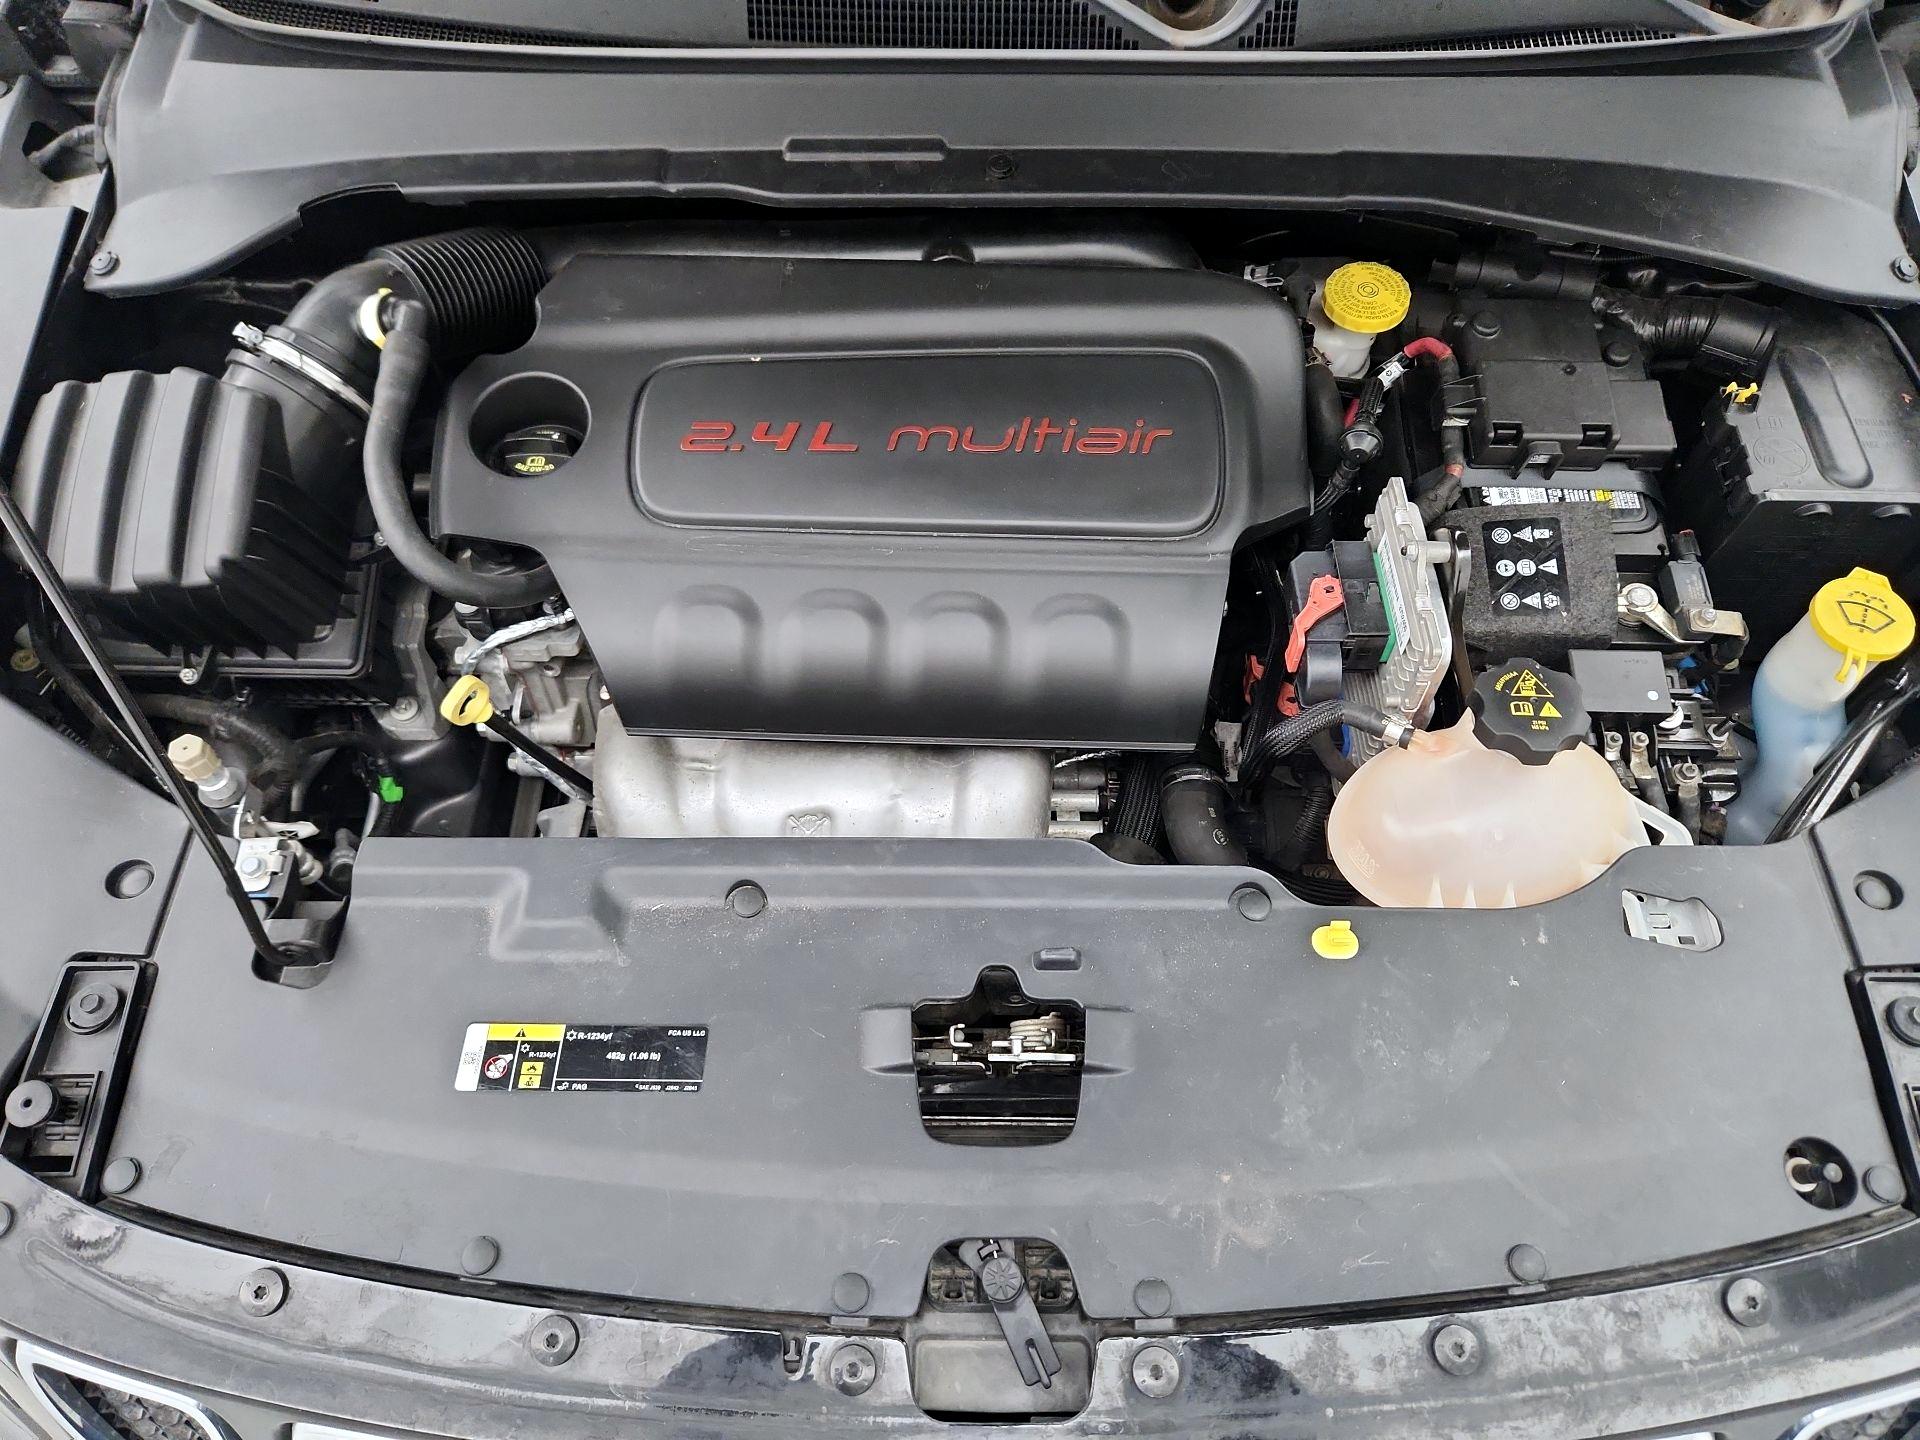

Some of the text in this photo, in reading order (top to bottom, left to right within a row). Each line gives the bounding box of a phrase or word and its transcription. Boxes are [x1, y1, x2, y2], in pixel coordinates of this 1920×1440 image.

[886, 416, 1174, 455] multiair
[515, 462, 555, 472] SAE 0W-20
[577, 1031, 613, 1041] R-1234yf
[528, 1051, 557, 1060] R-1234yf
[571, 1083, 588, 1091] PAG
